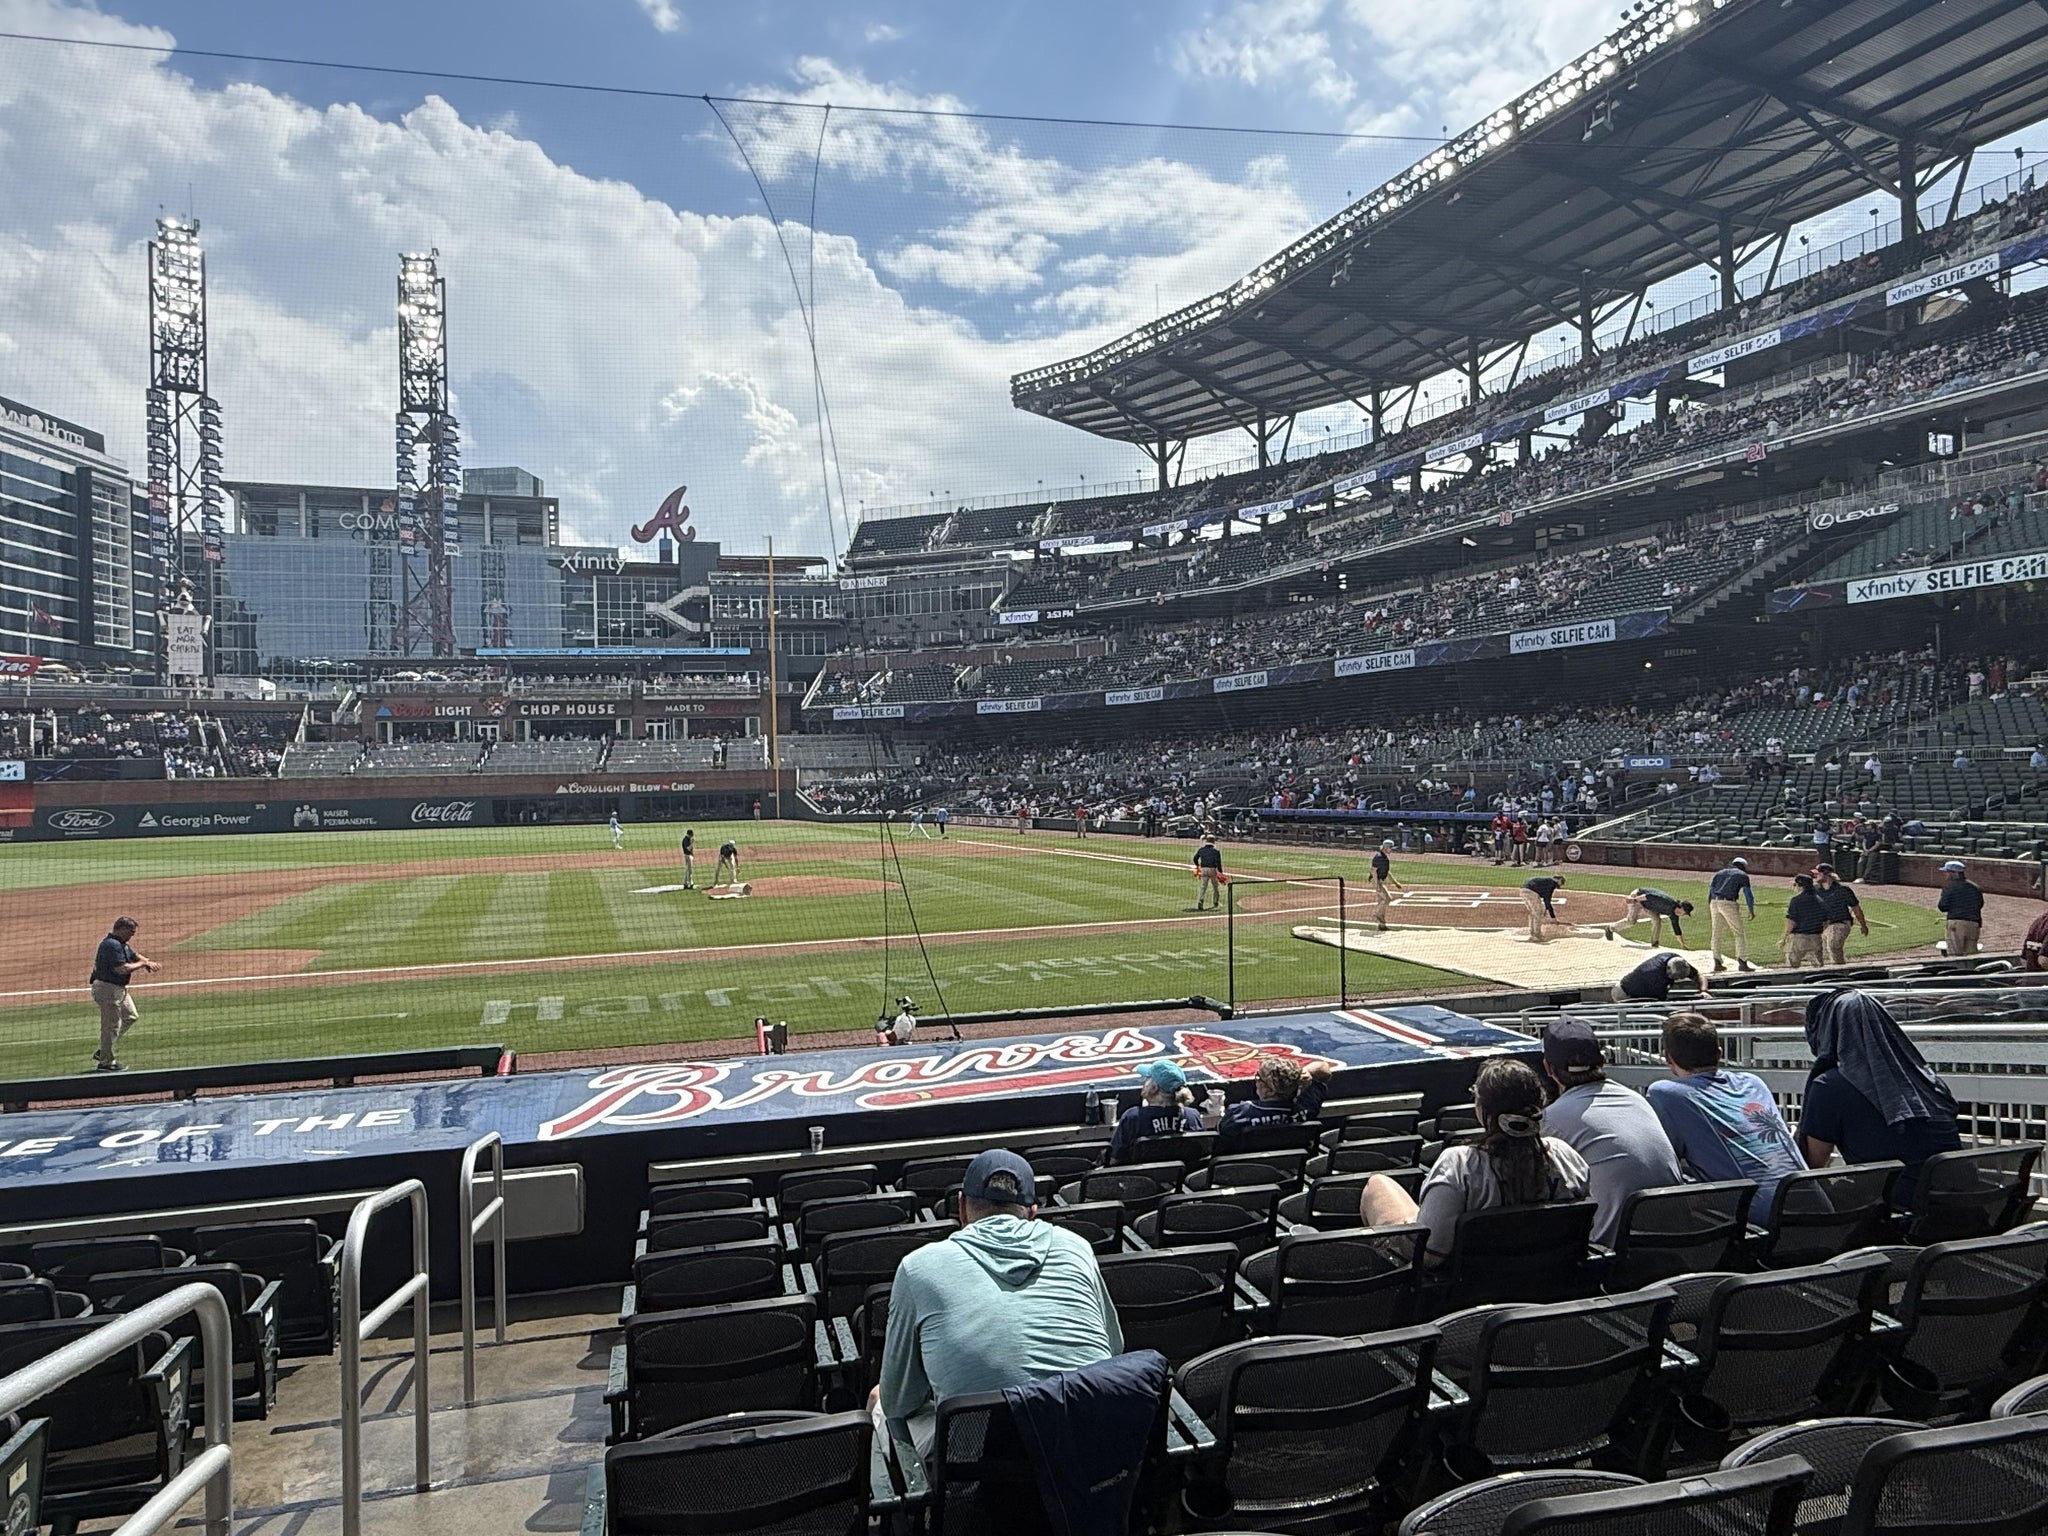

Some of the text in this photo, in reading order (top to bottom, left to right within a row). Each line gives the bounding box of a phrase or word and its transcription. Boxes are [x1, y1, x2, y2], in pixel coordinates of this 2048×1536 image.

[44, 417, 85, 448] HOTEL
[1747, 441, 1767, 463] 21
[1835, 502, 1899, 524] LEXUS
[560, 552, 628, 575] xfinity
[1855, 576, 1918, 599] xfinity
[1926, 563, 1995, 591] SELFIE
[177, 626, 194, 634] EAT
[176, 634, 196, 643] MOR
[1514, 633, 1546, 650] xfinity
[1550, 627, 1585, 645] SELFIE
[1365, 655, 1392, 670] SELFIE
[434, 705, 472, 717] LIGHT
[520, 703, 616, 716] CHOP HOUSE
[664, 704, 691, 712] MADE
[692, 704, 705, 712] TO
[1630, 757, 1664, 767] GEICO
[568, 782, 598, 794] Coors
[598, 784, 626, 793] LIGHT
[630, 783, 661, 793] BELOW
[671, 782, 696, 792] CHOP
[60, 811, 104, 827] Ford
[323, 809, 349, 818] KAISER
[411, 801, 477, 823] Coca-Cola
[161, 813, 252, 828] Georgia Power
[538, 1027, 1166, 1141] Braves
[99, 1123, 224, 1148] OF
[252, 1108, 411, 1136] THE
